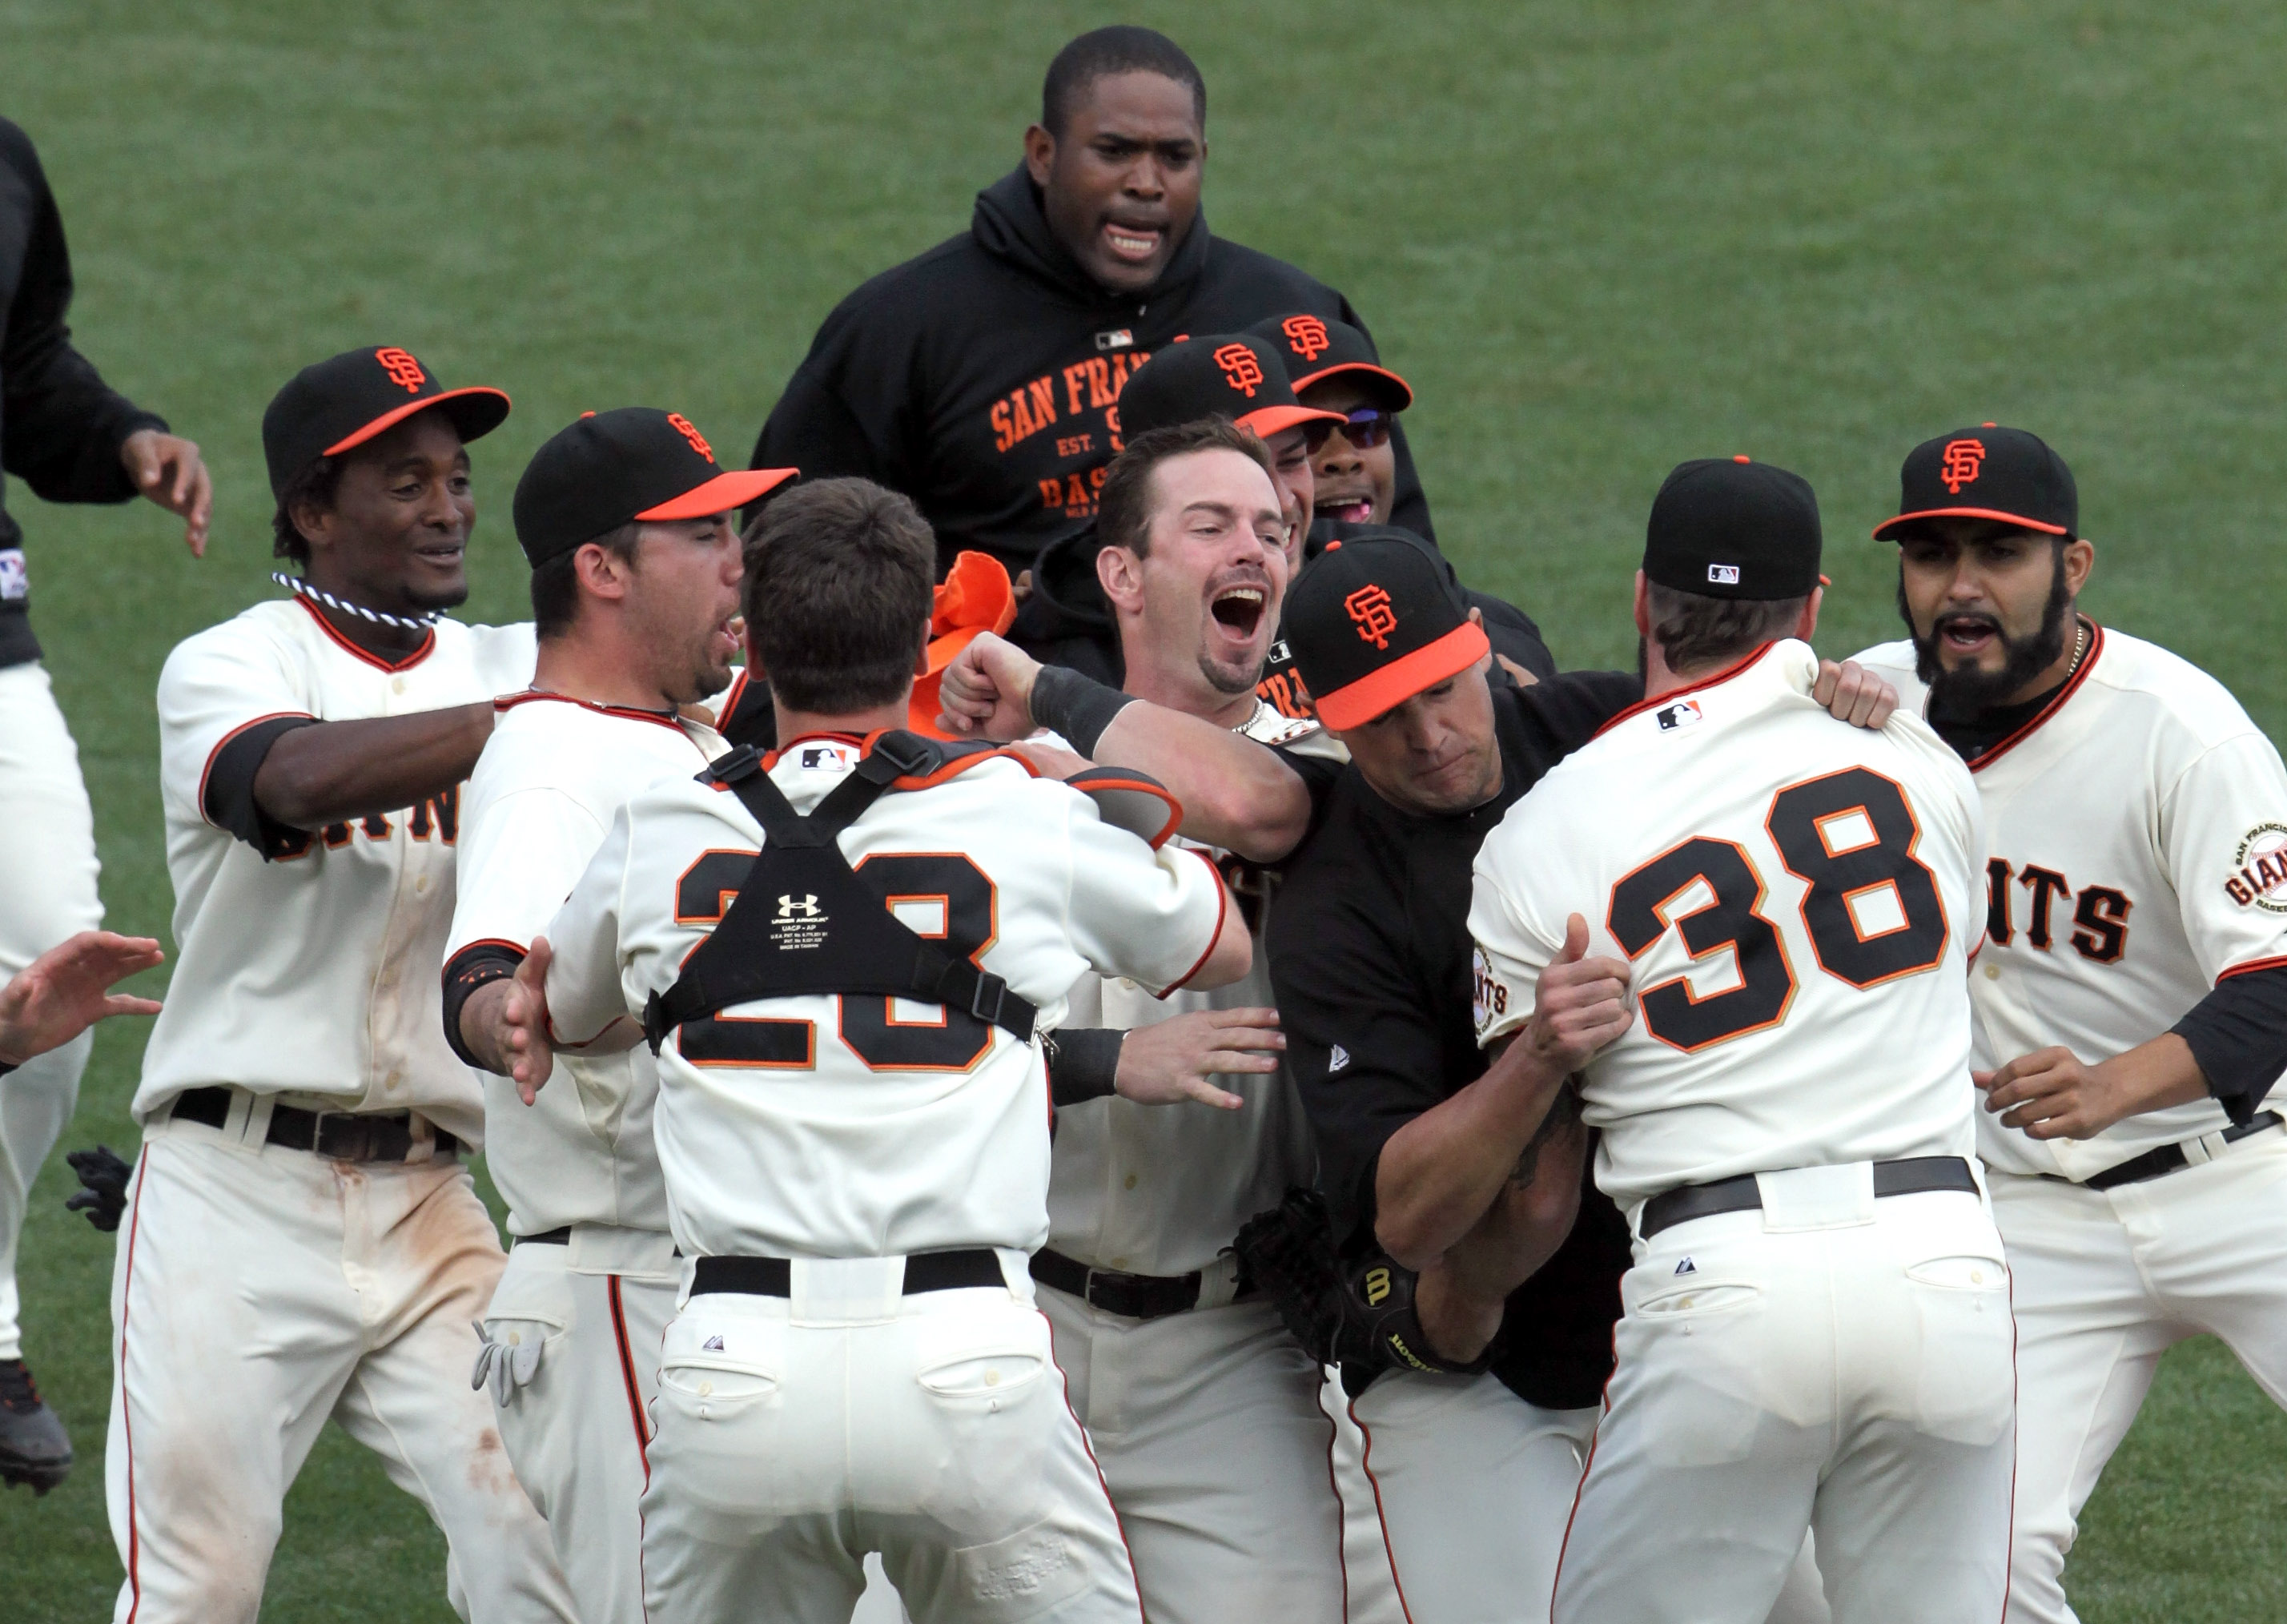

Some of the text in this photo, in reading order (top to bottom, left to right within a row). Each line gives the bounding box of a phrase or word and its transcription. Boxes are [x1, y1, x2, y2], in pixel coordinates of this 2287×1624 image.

[1283, 314, 1330, 362] SF
[375, 347, 426, 394] SF
[1213, 343, 1264, 397] SF
[991, 375, 1057, 453] SAN
[1056, 433, 1095, 457] EST.
[1940, 439, 1985, 494] SF
[1344, 583, 1397, 650] SF
[1606, 765, 1950, 1054] 38
[674, 849, 999, 1074] 28
